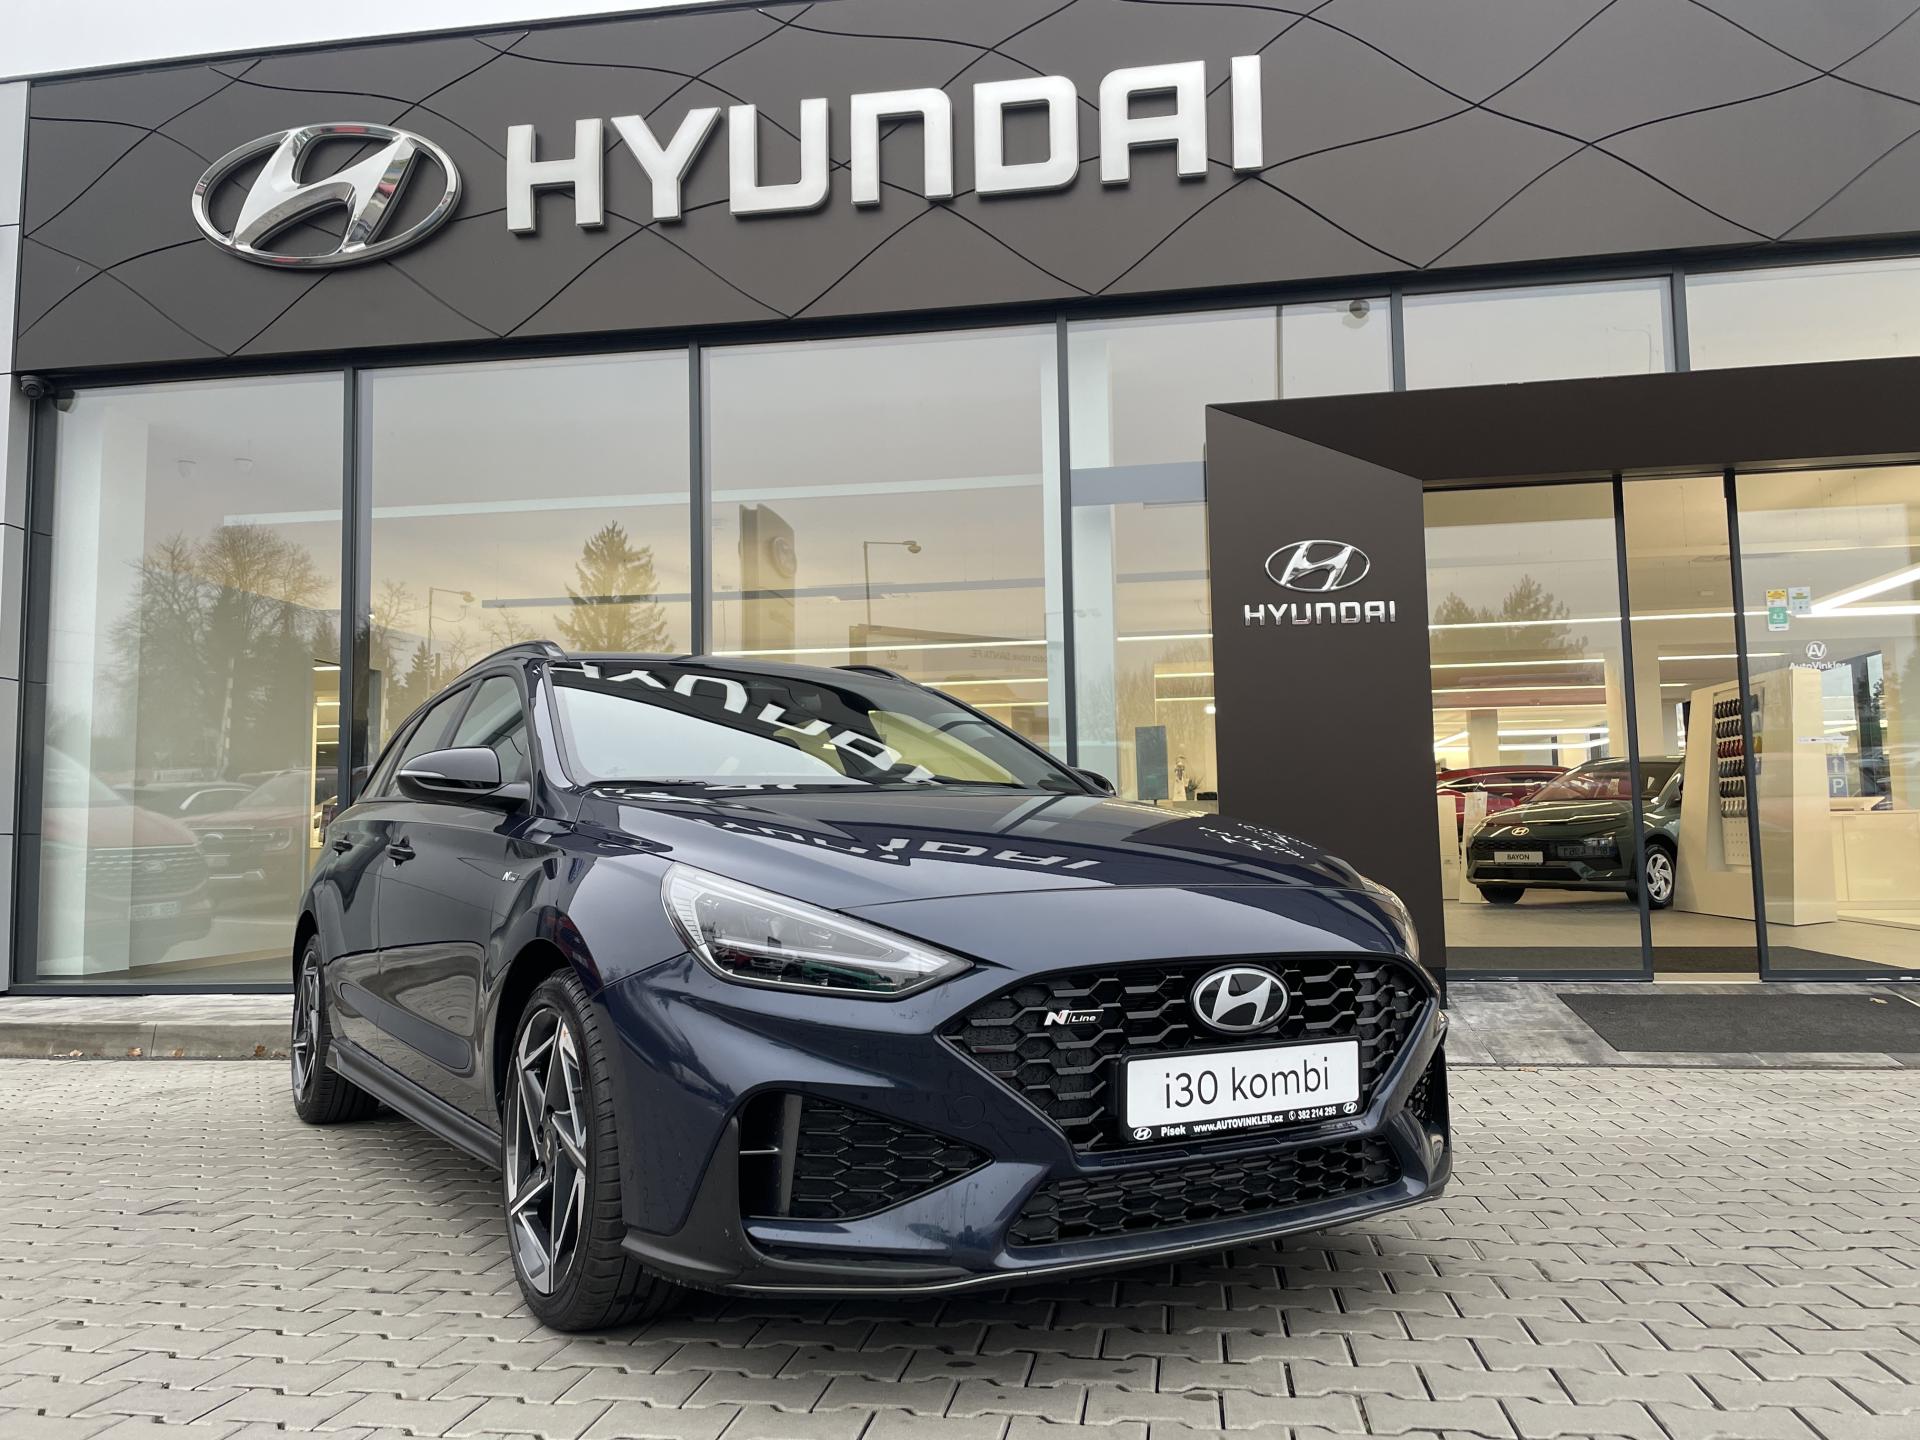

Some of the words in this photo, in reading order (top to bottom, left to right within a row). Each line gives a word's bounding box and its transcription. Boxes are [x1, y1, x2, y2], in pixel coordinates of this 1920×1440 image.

[507, 54, 1264, 234] HYUNDAI
[1244, 600, 1396, 626] HYUNDAI
[1507, 853, 1530, 861] BAYON
[1071, 1015, 1096, 1023] Line
[1165, 1070, 1218, 1109] i30
[1231, 1056, 1329, 1101] kombi
[1193, 1113, 1284, 1133] www.AUTOVINKLER.cz
[1297, 1108, 1310, 1120] 382
[1311, 1107, 1324, 1118] 214
[1324, 1106, 1337, 1117] 295
